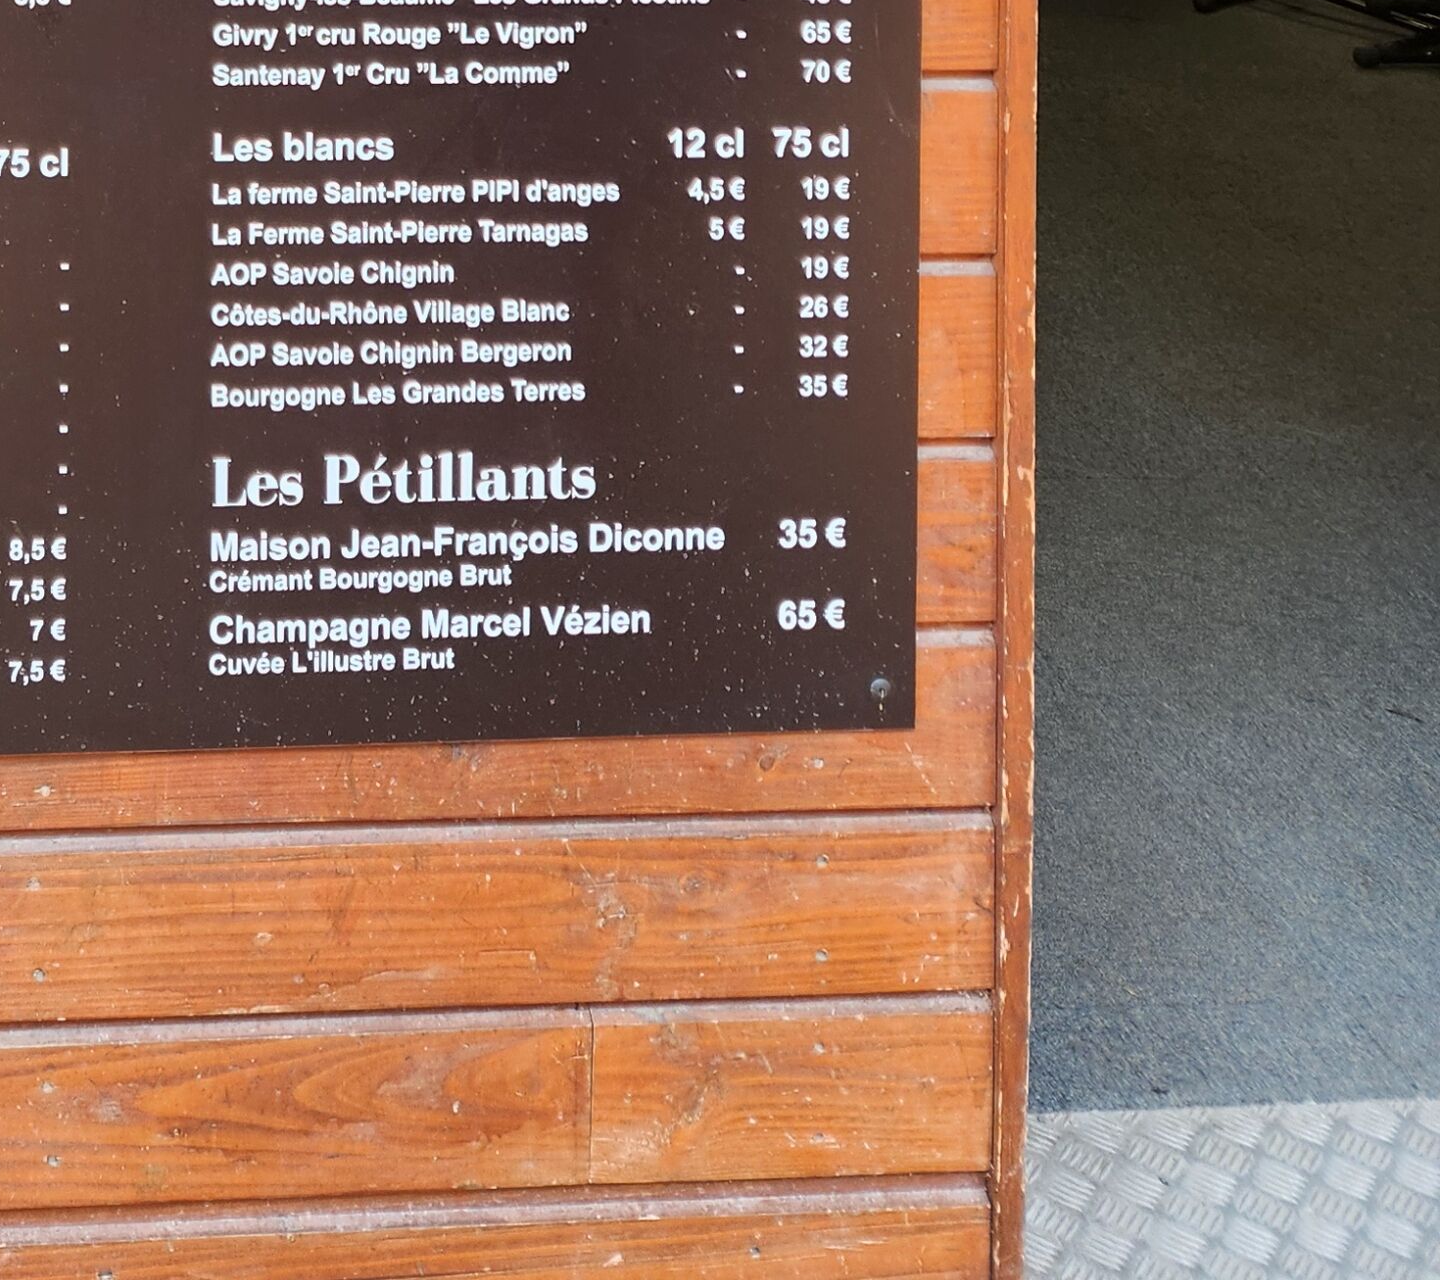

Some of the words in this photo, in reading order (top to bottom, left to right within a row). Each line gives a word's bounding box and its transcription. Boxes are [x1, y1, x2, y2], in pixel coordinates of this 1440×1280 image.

[209, 131, 274, 163] Les
[282, 130, 395, 162] blancs
[211, 455, 304, 508] Les
[323, 449, 597, 505] Pétillants
[209, 529, 331, 563] Maison
[340, 523, 579, 562] Jean-François
[588, 521, 726, 553] Diconne
[208, 568, 314, 594] Crémant
[318, 566, 454, 595] Bourgogne
[459, 563, 513, 587] Brut
[208, 613, 412, 650] Champagne
[420, 605, 531, 640] Marcel
[539, 603, 652, 637] Vézien
